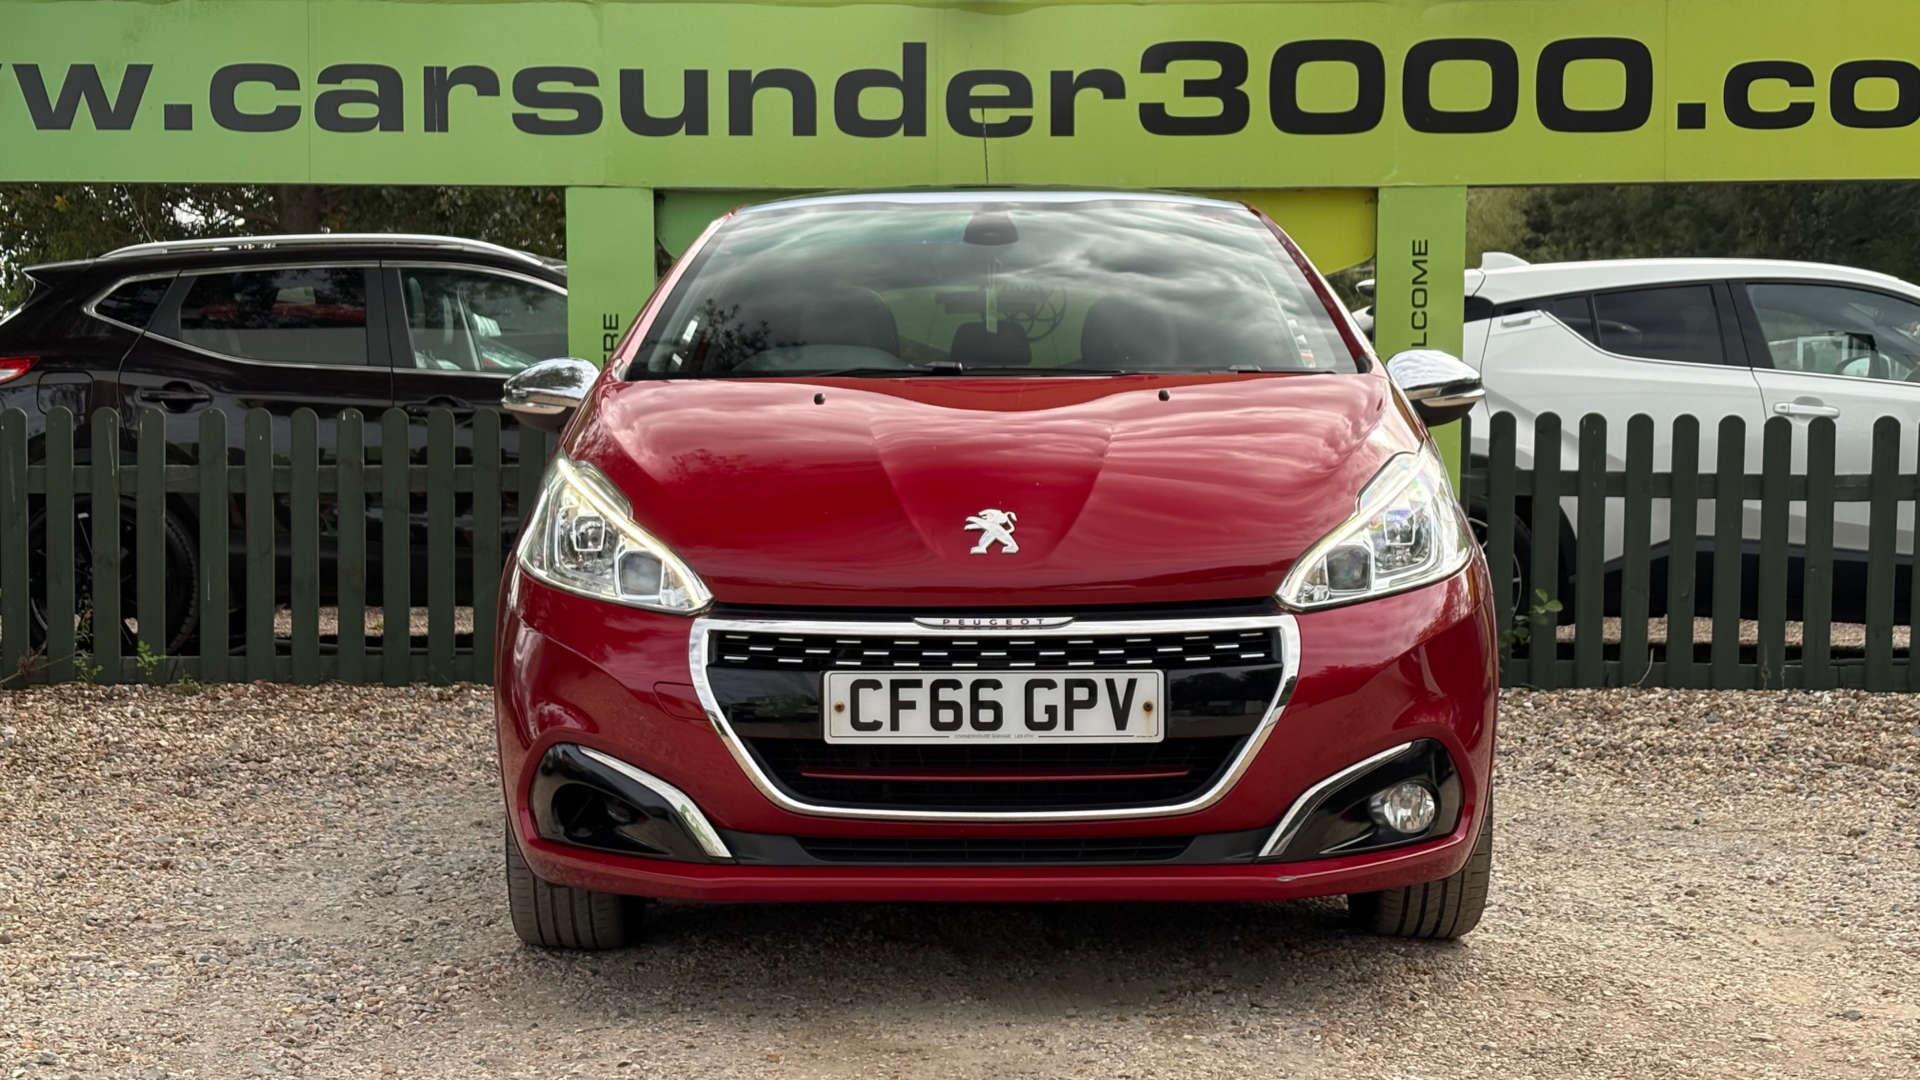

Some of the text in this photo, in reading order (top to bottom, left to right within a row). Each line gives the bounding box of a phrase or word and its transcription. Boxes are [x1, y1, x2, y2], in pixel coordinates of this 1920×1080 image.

[0, 37, 1920, 137] w.carsunder3000.co
[1411, 239, 1428, 347] LCOME
[942, 618, 1045, 626] PEUGEOT
[850, 678, 1138, 732] CF66 GPV
